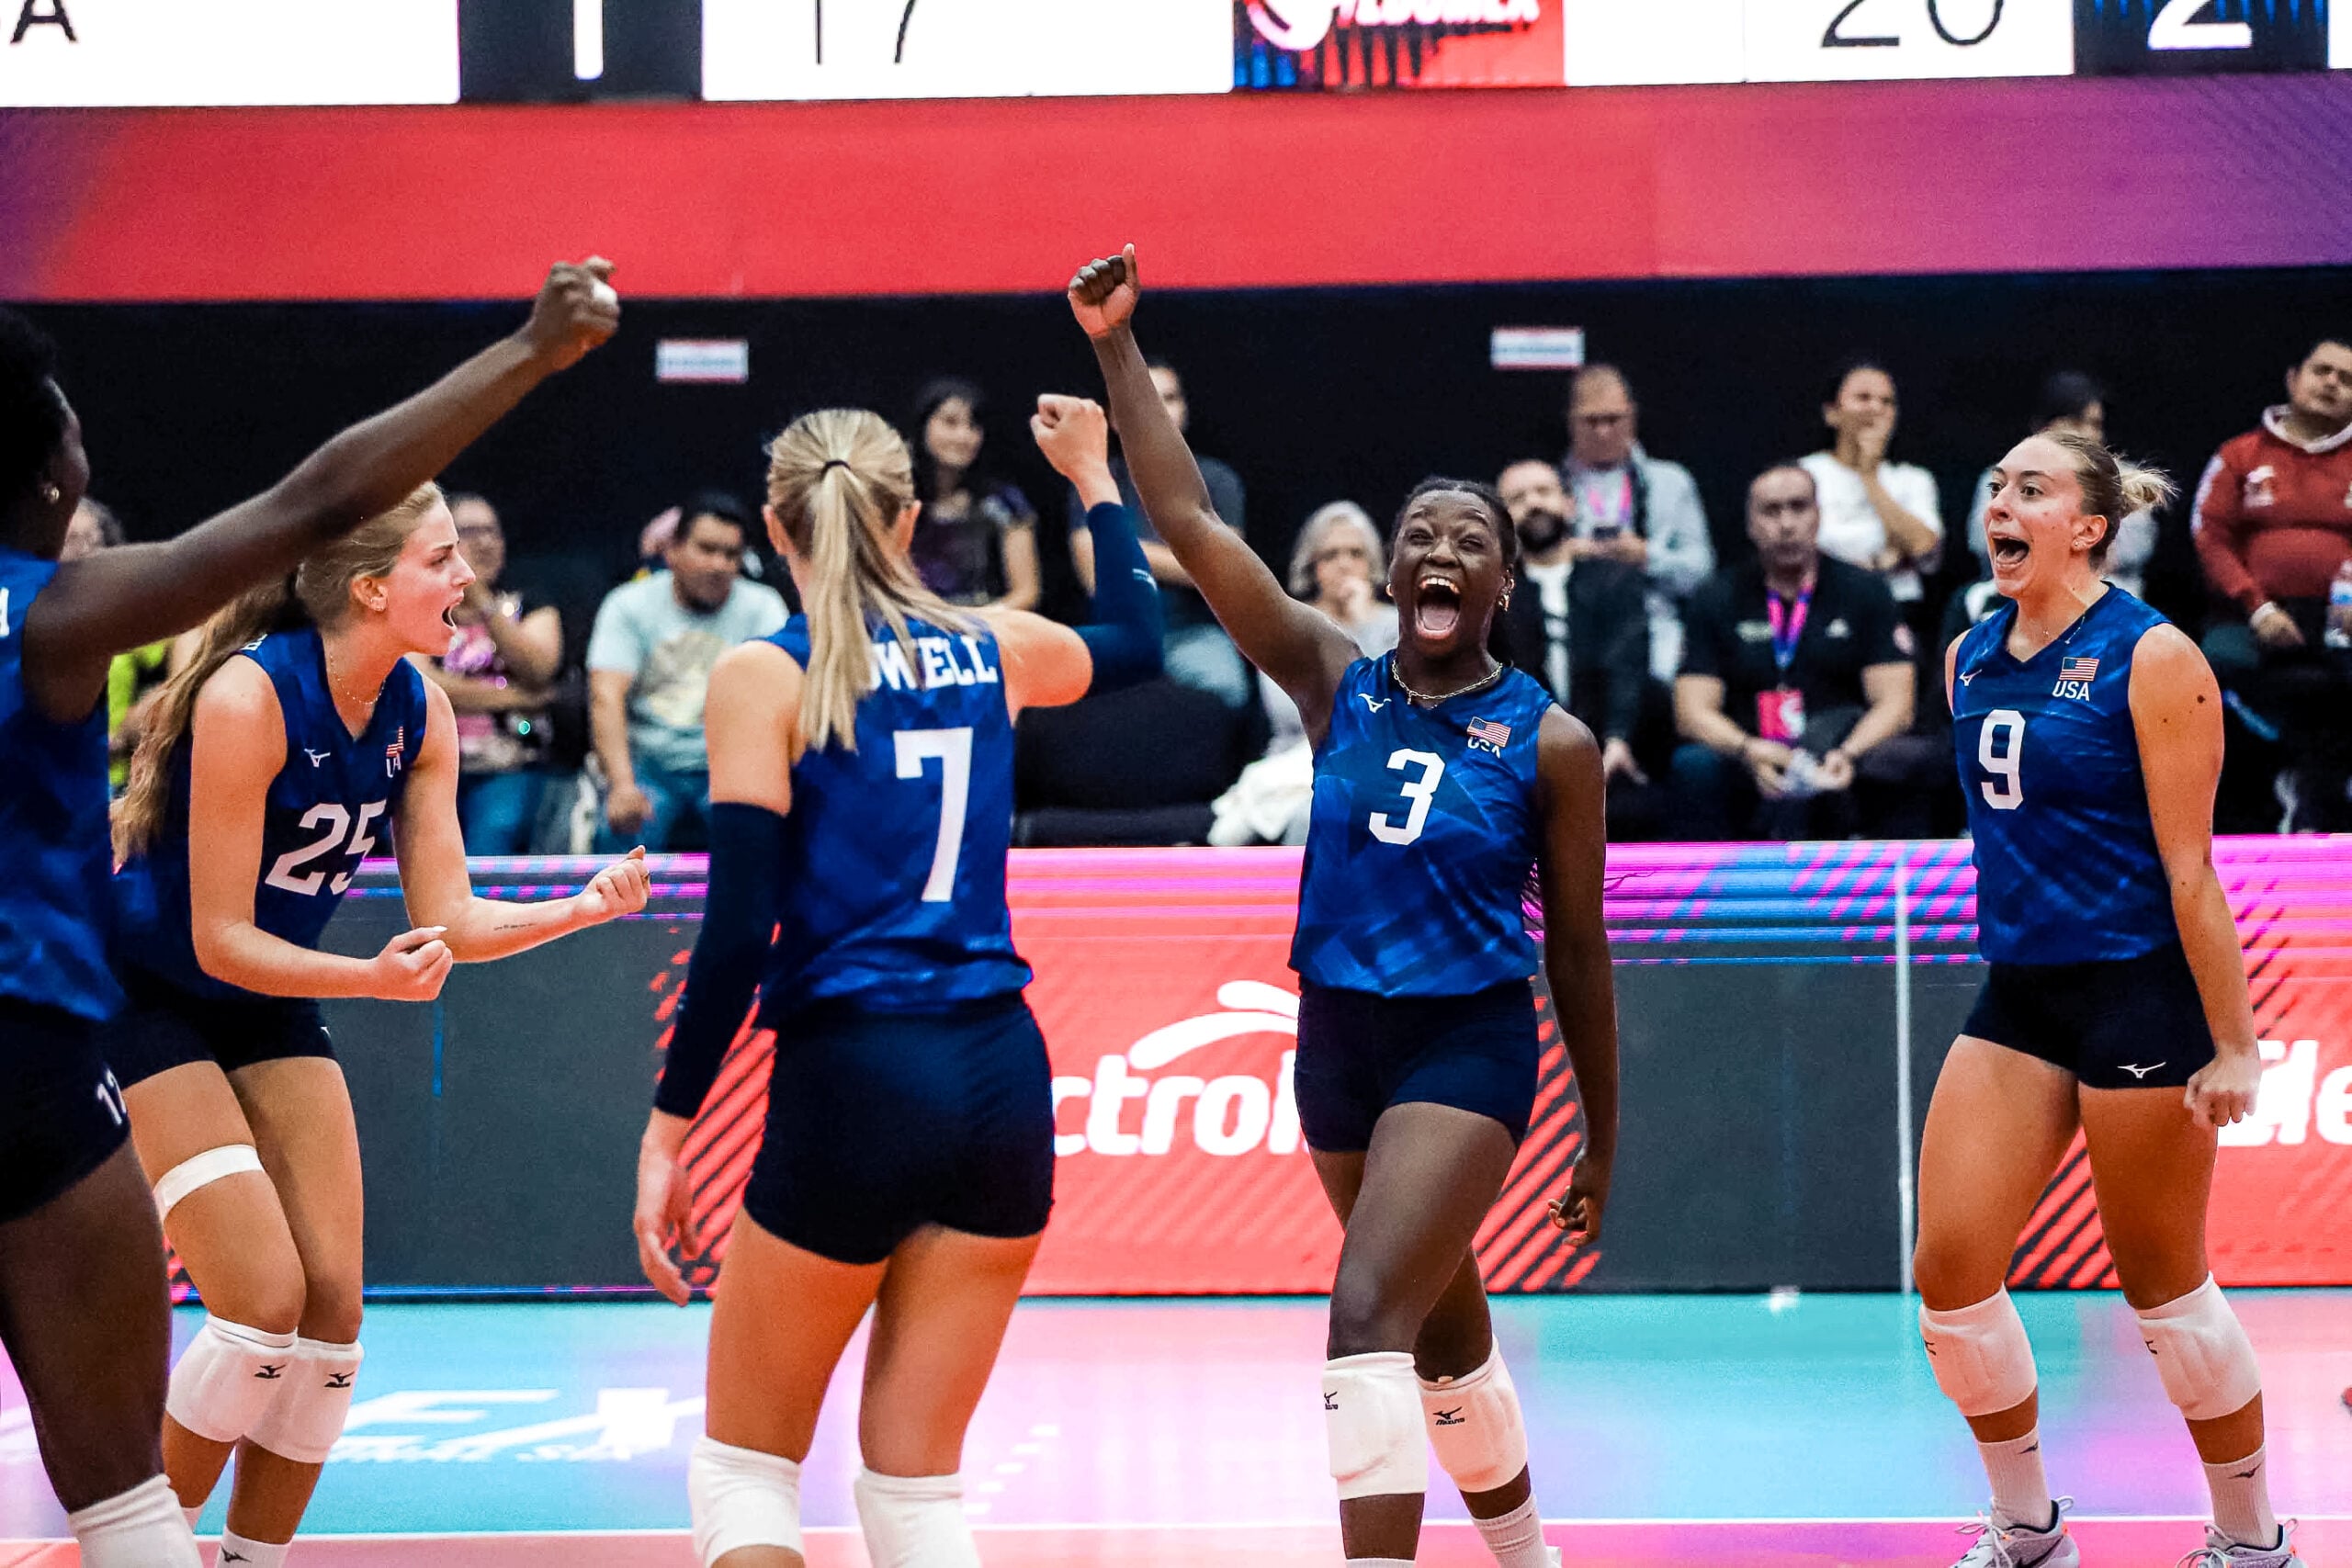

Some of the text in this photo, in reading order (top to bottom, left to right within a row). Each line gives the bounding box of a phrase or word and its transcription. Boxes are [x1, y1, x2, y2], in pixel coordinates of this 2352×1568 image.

[871, 636, 999, 691] WELL
[2052, 681, 2090, 701] USA
[1369, 748, 1446, 846] 3
[1467, 737, 1501, 759] USA
[1979, 709, 2026, 809] 9
[265, 798, 387, 897] 25
[893, 727, 974, 903] 7
[1051, 1049, 1310, 1156] ctrol
